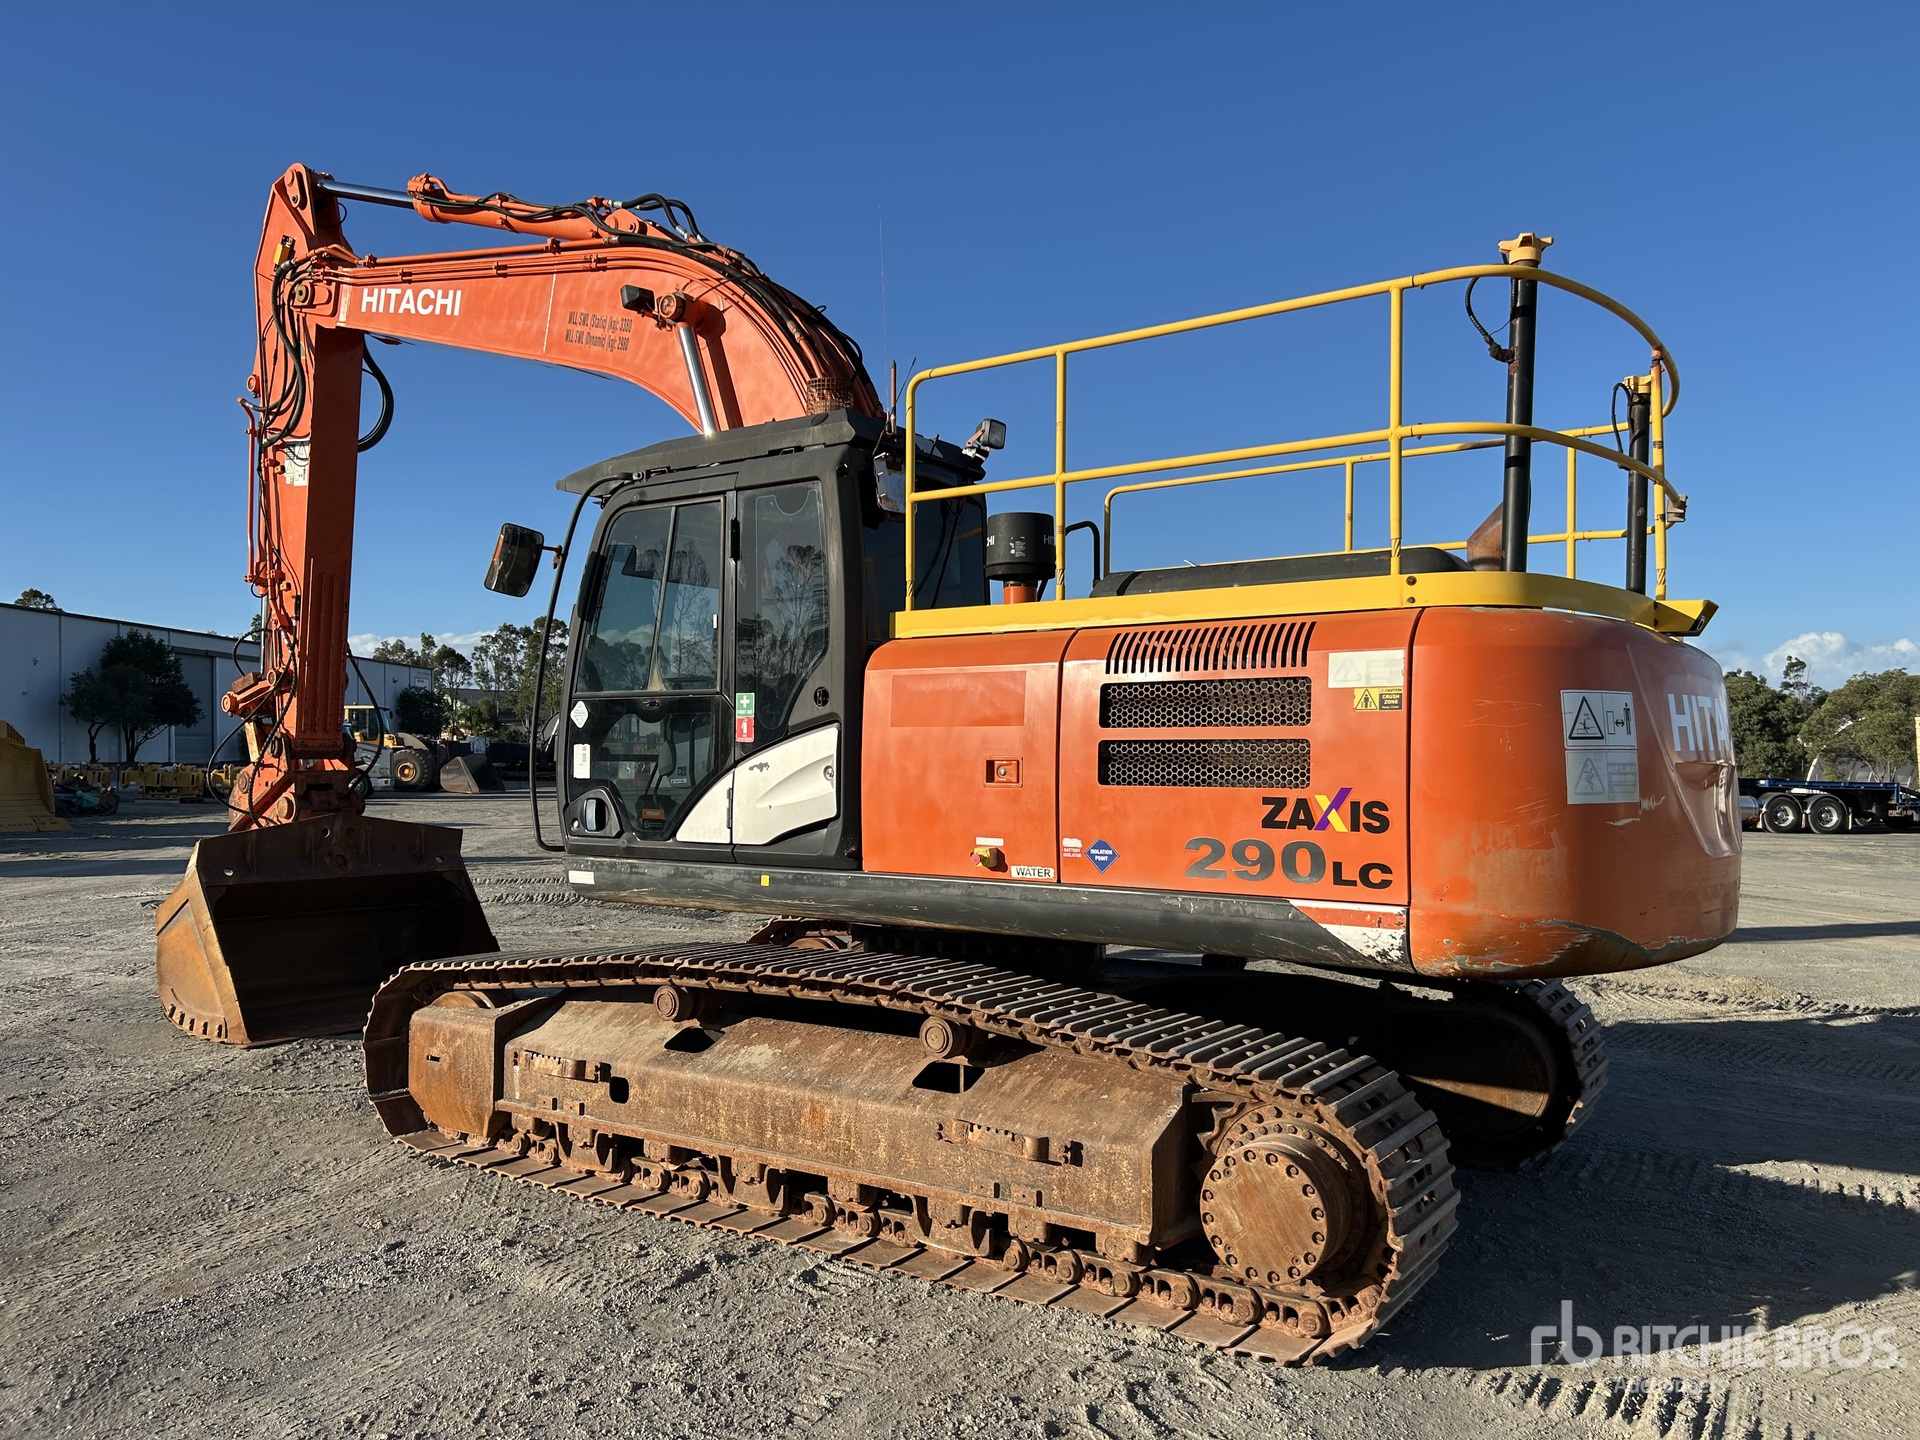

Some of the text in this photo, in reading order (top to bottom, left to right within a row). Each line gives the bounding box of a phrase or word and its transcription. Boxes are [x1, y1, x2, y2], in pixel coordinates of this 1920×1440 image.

[361, 288, 462, 316] HITACHI
[1262, 787, 1390, 834] ZAXIS
[1016, 867, 1051, 877] WATER
